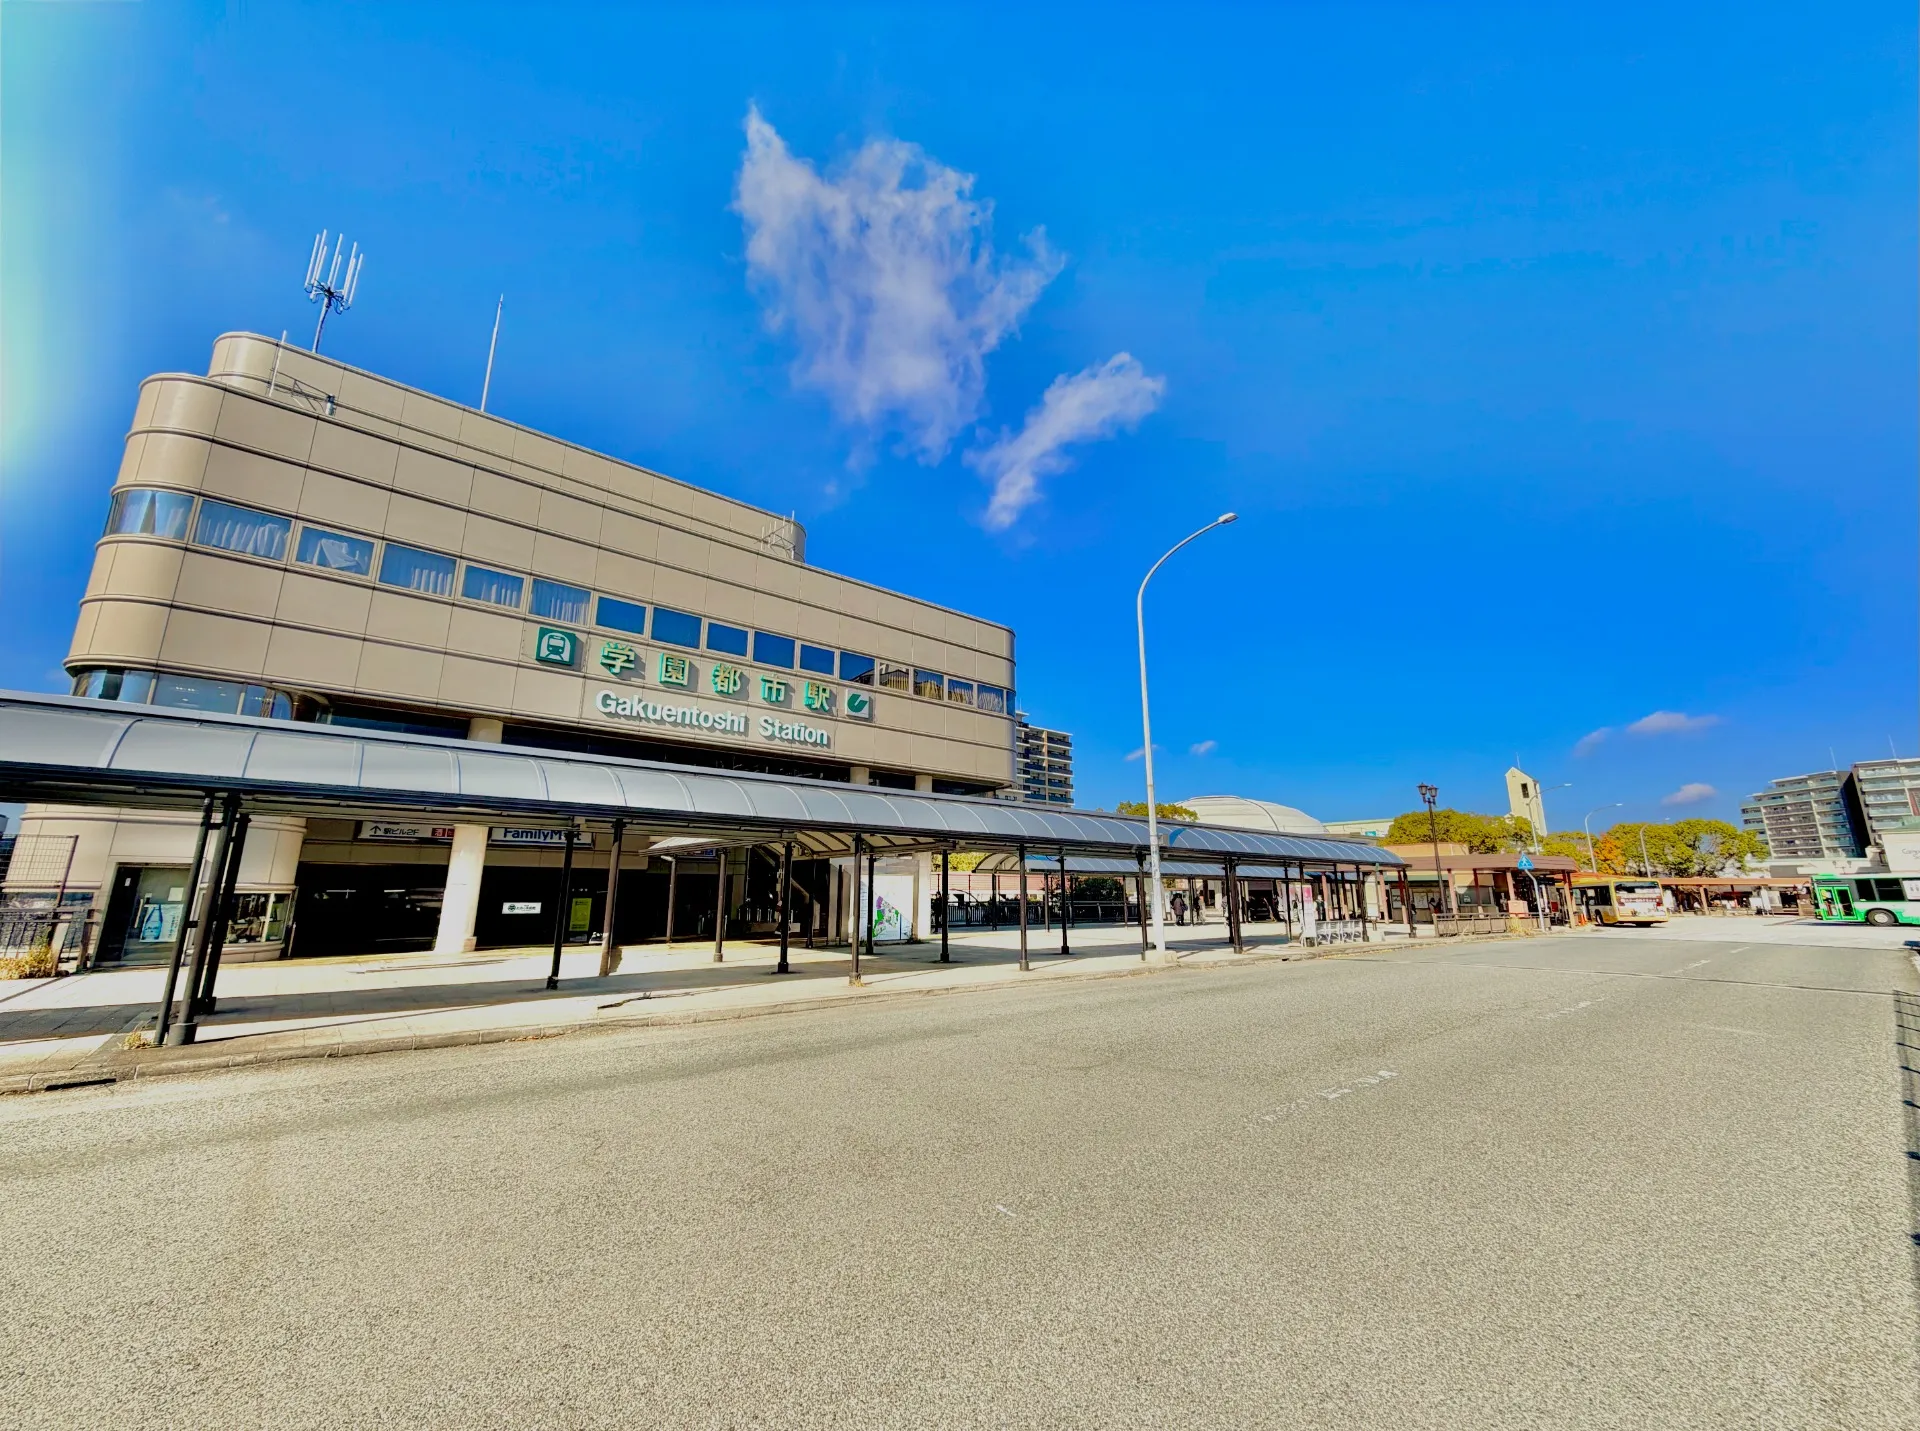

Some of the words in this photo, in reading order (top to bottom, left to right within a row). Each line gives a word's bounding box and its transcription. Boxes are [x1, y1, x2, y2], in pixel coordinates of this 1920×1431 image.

[600, 641, 830, 712] 学園都市駅
[596, 689, 746, 733] Gakuentoshi
[758, 715, 828, 745] Station
[503, 828, 582, 841] FamilyMt
